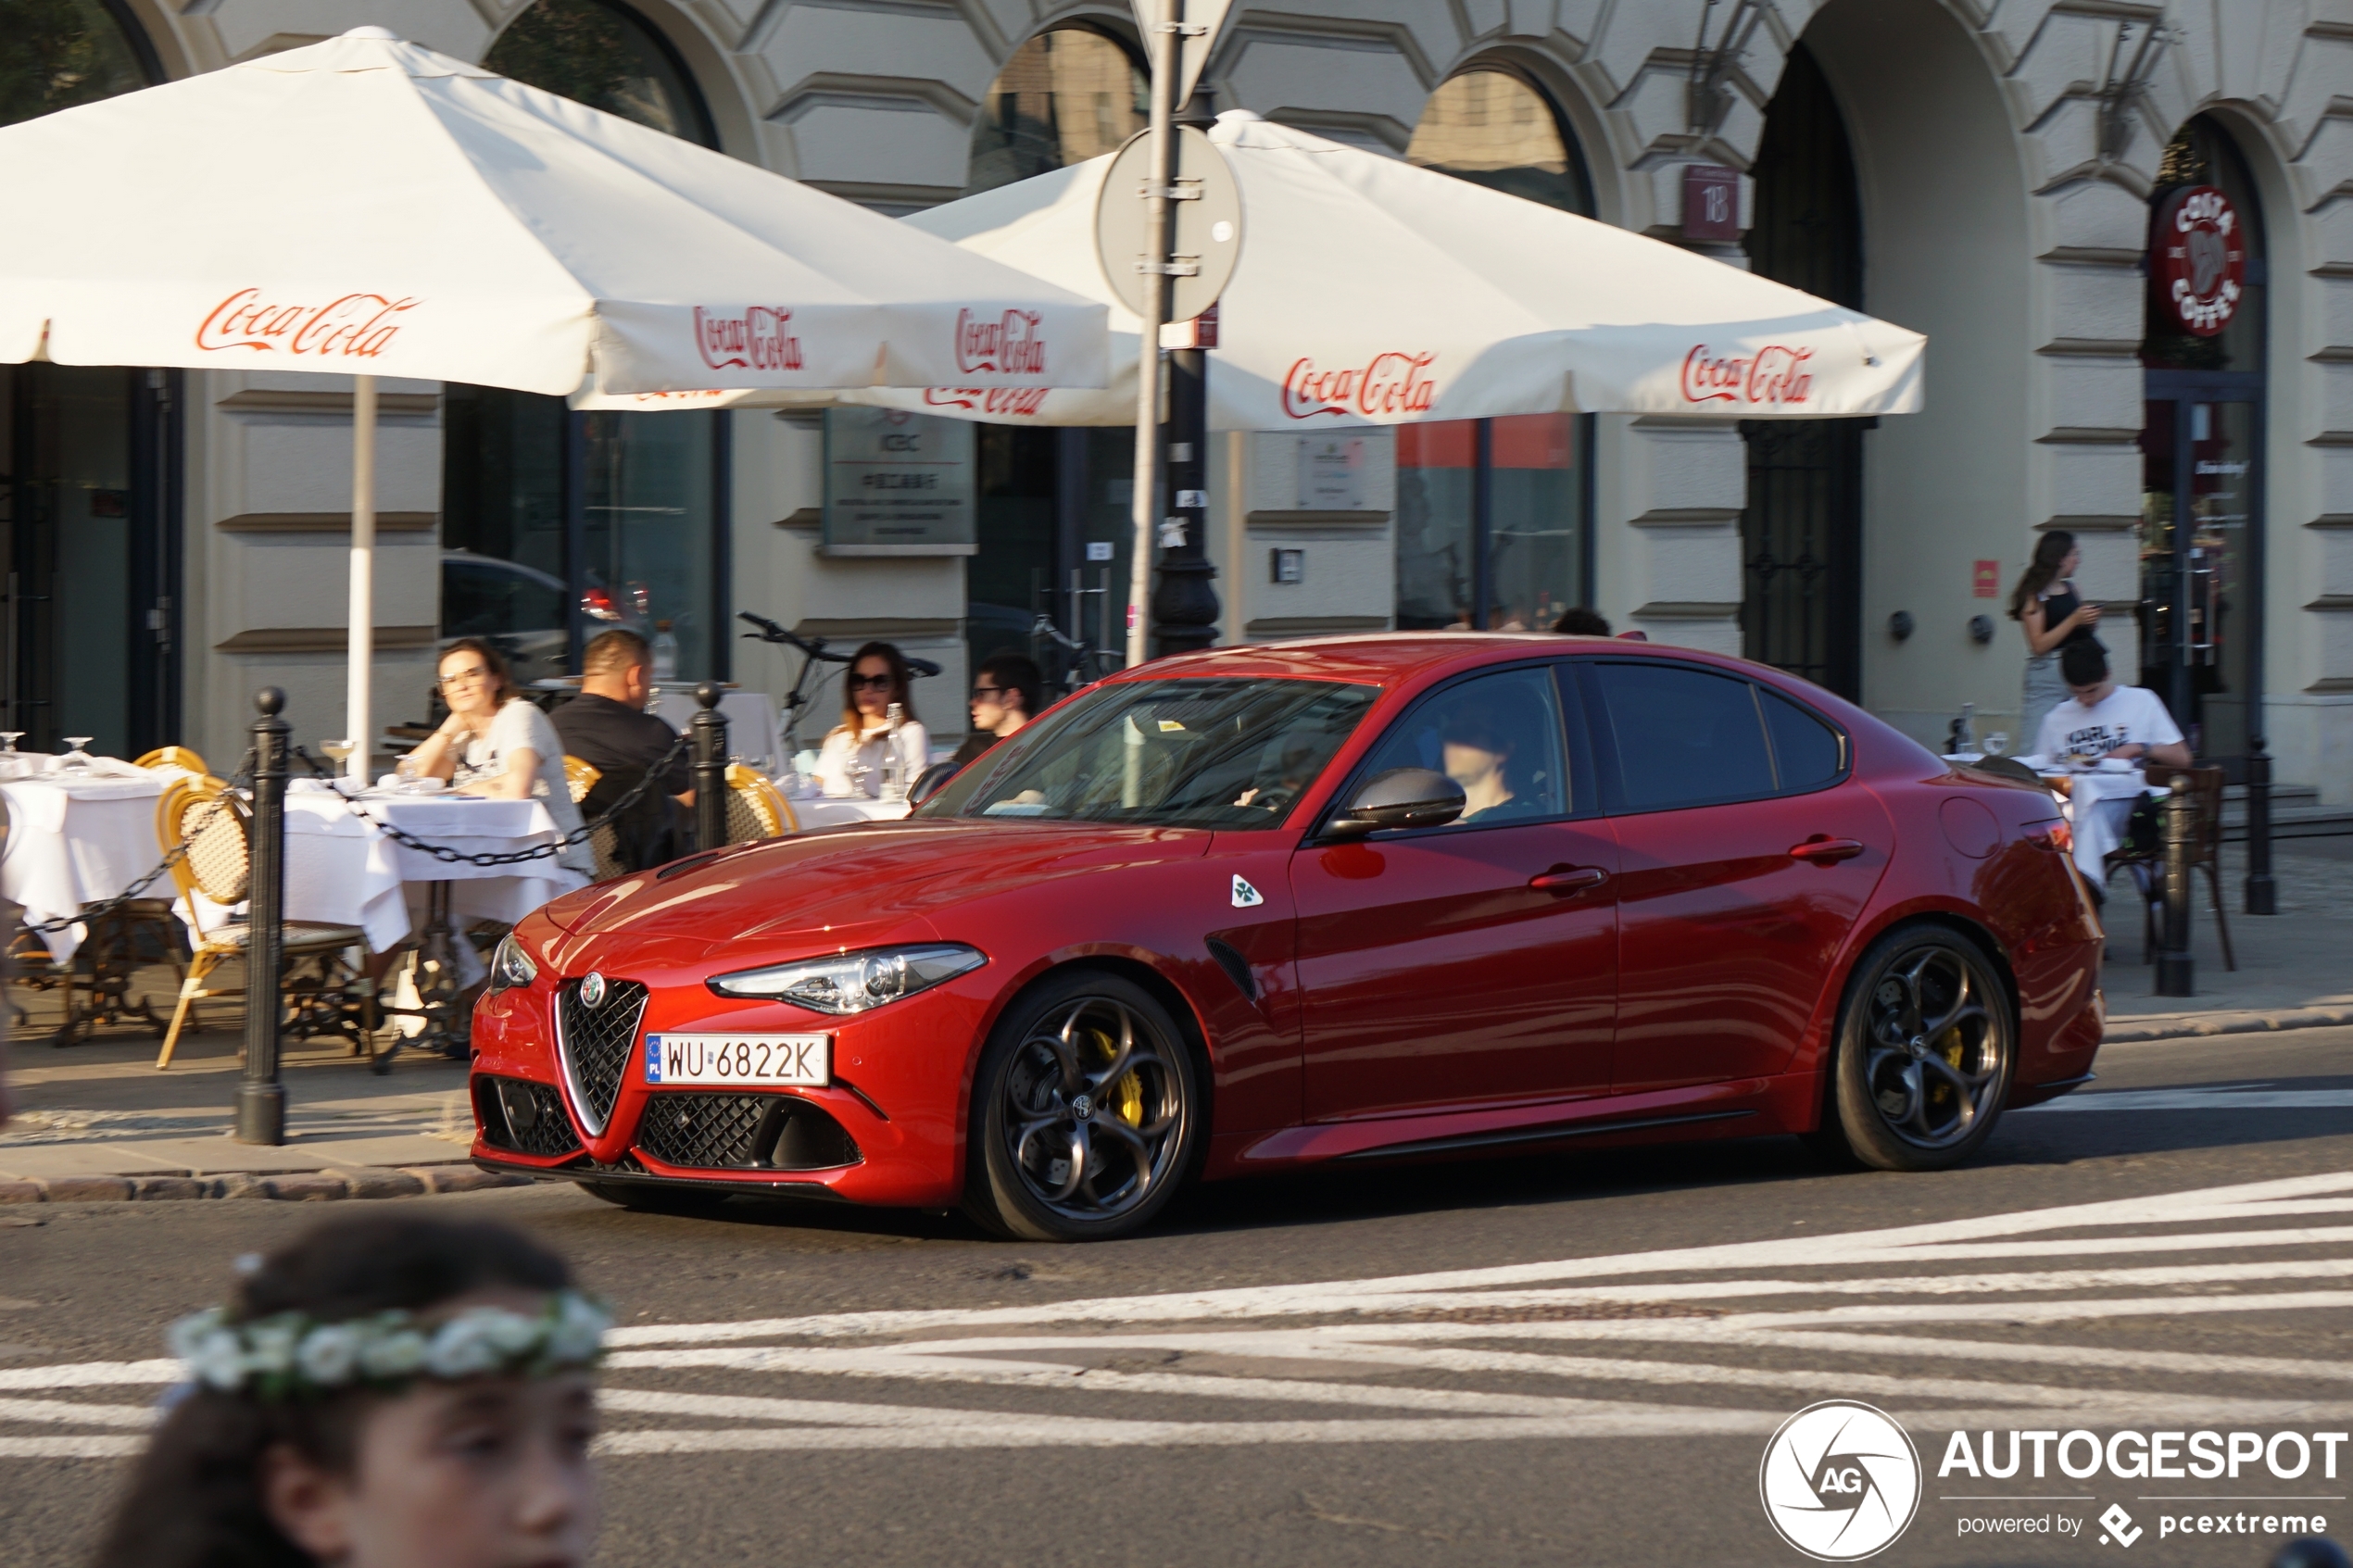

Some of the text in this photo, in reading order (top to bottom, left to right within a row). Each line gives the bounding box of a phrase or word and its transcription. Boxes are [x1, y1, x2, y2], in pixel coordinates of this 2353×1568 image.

[2176, 192, 2235, 237] COSTA
[2171, 278, 2242, 330] COFFEE
[649, 1063, 661, 1074] PL
[668, 1042, 815, 1078] WU 6822K
